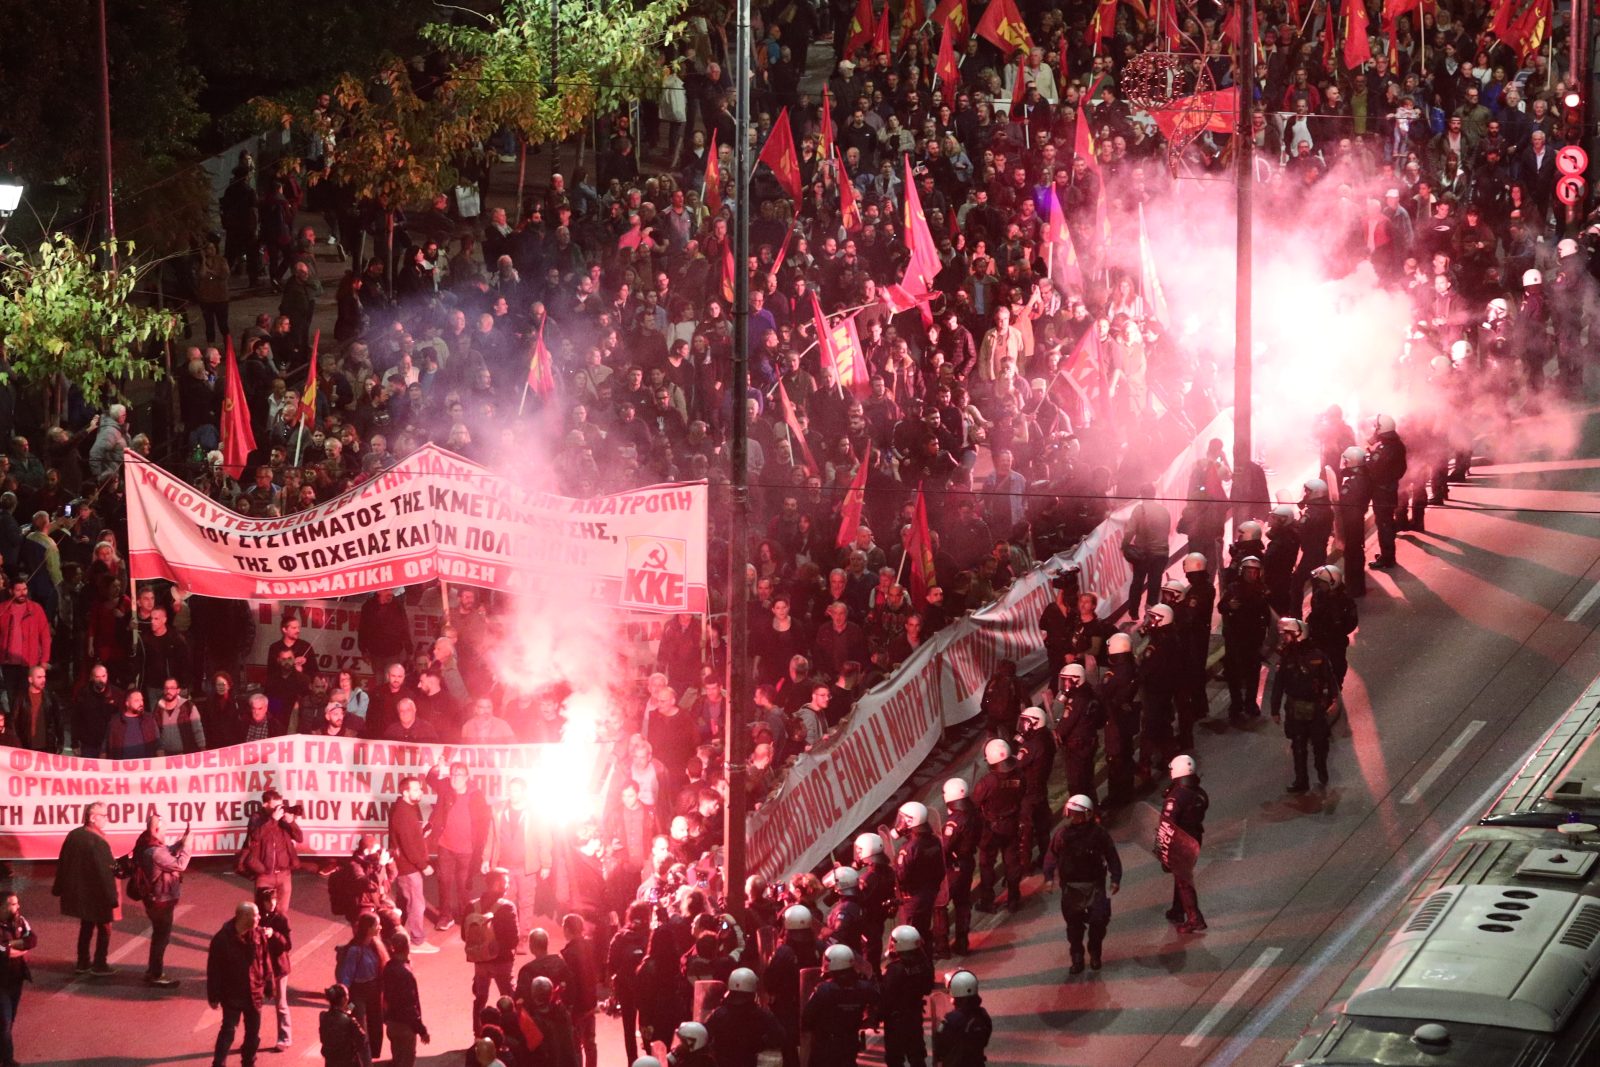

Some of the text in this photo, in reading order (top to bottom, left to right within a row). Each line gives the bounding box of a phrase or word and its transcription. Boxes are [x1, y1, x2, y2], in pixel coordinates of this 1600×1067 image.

[163, 483, 317, 532] ΠΟΛΥΤΕΧΝΕΙΟ
[569, 491, 692, 515] ΑΝΑΤΡΟΠΗ
[197, 524, 229, 546] ΤΟΥ
[239, 502, 386, 549] ΣΥΣΤΗΜΑΤΟΣ
[390, 491, 425, 516] ΤΗΣ
[233, 555, 272, 573] ΤΗΣ
[278, 529, 391, 573] ΦΤΩΧΕΙΑΣ
[396, 523, 430, 549] ΚΑΙ
[432, 519, 457, 546] ΩΝ
[255, 556, 495, 595] ΚΟΜΜΑΤΙΚΗ ΟΡΝΩΣΗ
[624, 568, 684, 606] ΚΚΕ
[165, 741, 294, 770] ΝΟΕΜΒΡΗ
[305, 741, 343, 764] ΓΙΑ
[353, 743, 434, 766] ΠΑΝΤΑ
[831, 724, 882, 810] ΕΙΝΑΙ
[868, 713, 894, 773] Η
[881, 675, 928, 757] ΝΙΟΤΗ
[8, 776, 130, 797] ΟΡΓΑΝΩΣΗ
[140, 776, 178, 795] ΚΑΙ
[188, 770, 276, 793] ΑΓΩΝΑΣ
[286, 770, 319, 791] ΓΙΑ
[328, 771, 372, 793] ΤΗΝ
[33, 802, 158, 825] ΔΙΚΤΟΡΙΑ
[168, 802, 206, 822] ΤΟΥ
[216, 799, 341, 821] ΚΕΦΑΙΟΥ
